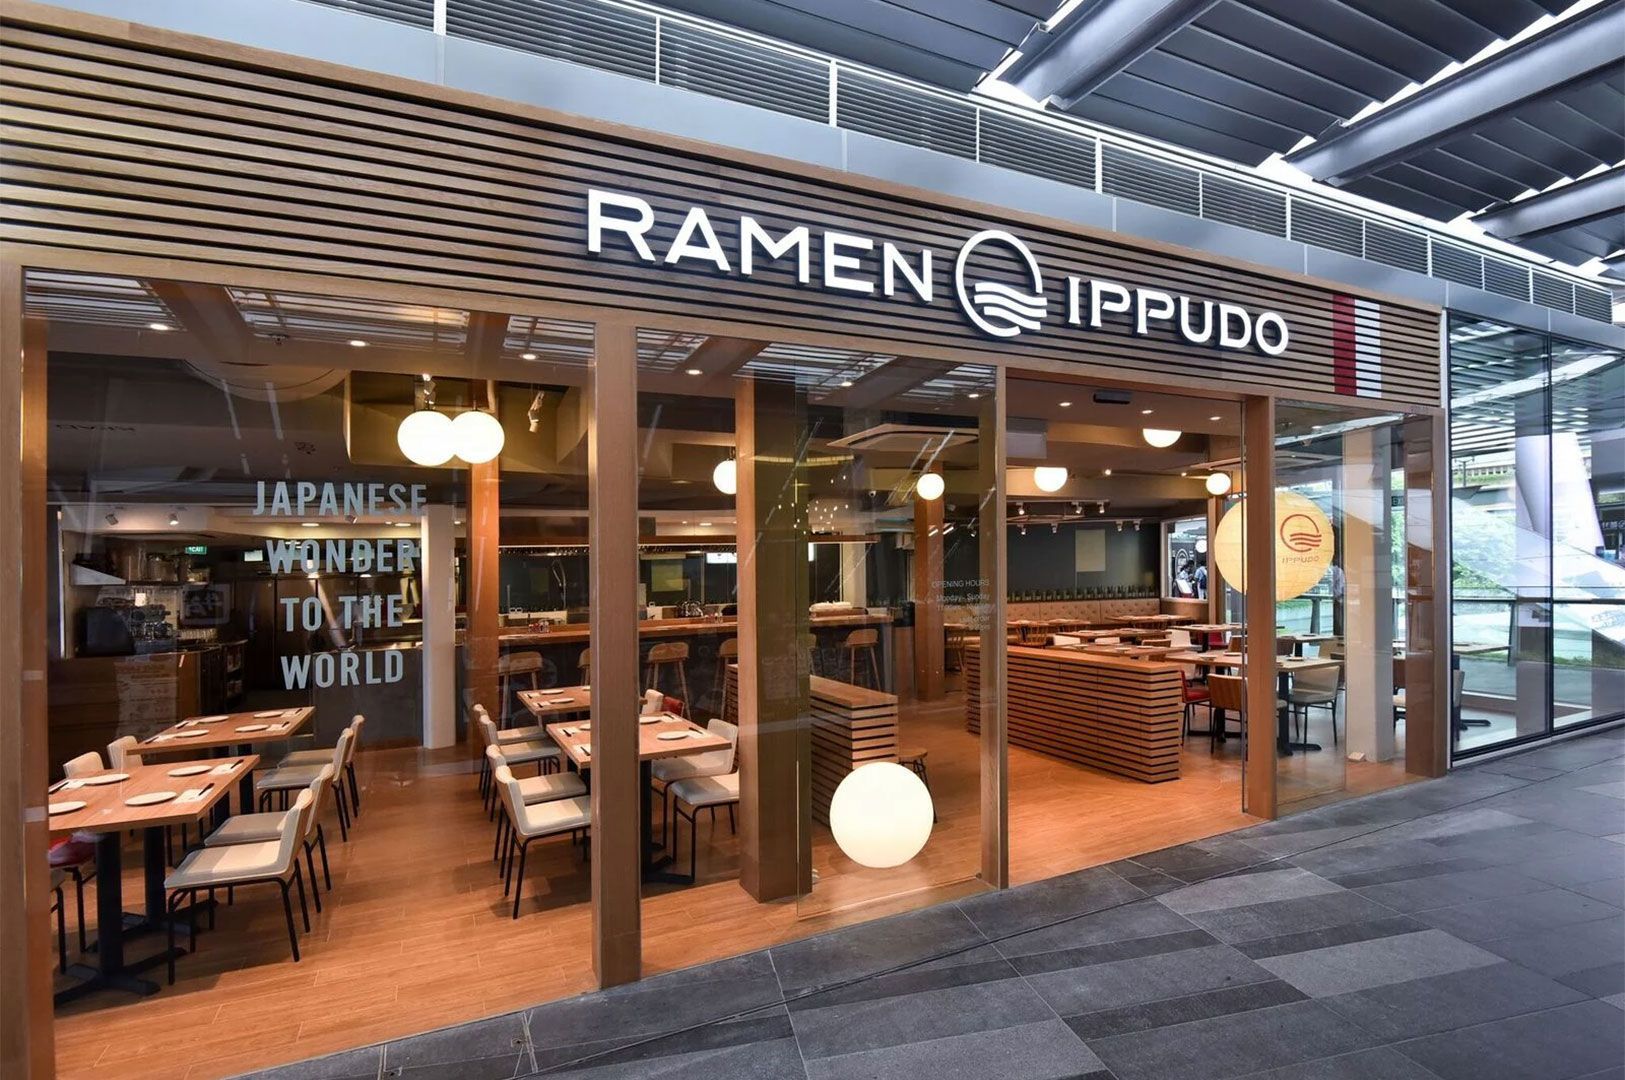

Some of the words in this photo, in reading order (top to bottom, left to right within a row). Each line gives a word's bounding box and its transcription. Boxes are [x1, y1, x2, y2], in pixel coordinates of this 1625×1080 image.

[588, 188, 933, 302] RAMEN
[1065, 275, 1289, 356] IPPUDO
[253, 481, 427, 516] JAPANESE
[266, 539, 415, 574] WONDER
[1282, 555, 1320, 564] IPPUDO
[932, 580, 964, 588] OPENING
[965, 579, 989, 587] HOURS
[280, 597, 322, 632] TO
[339, 594, 404, 629] THE
[280, 650, 404, 690] WORLD
